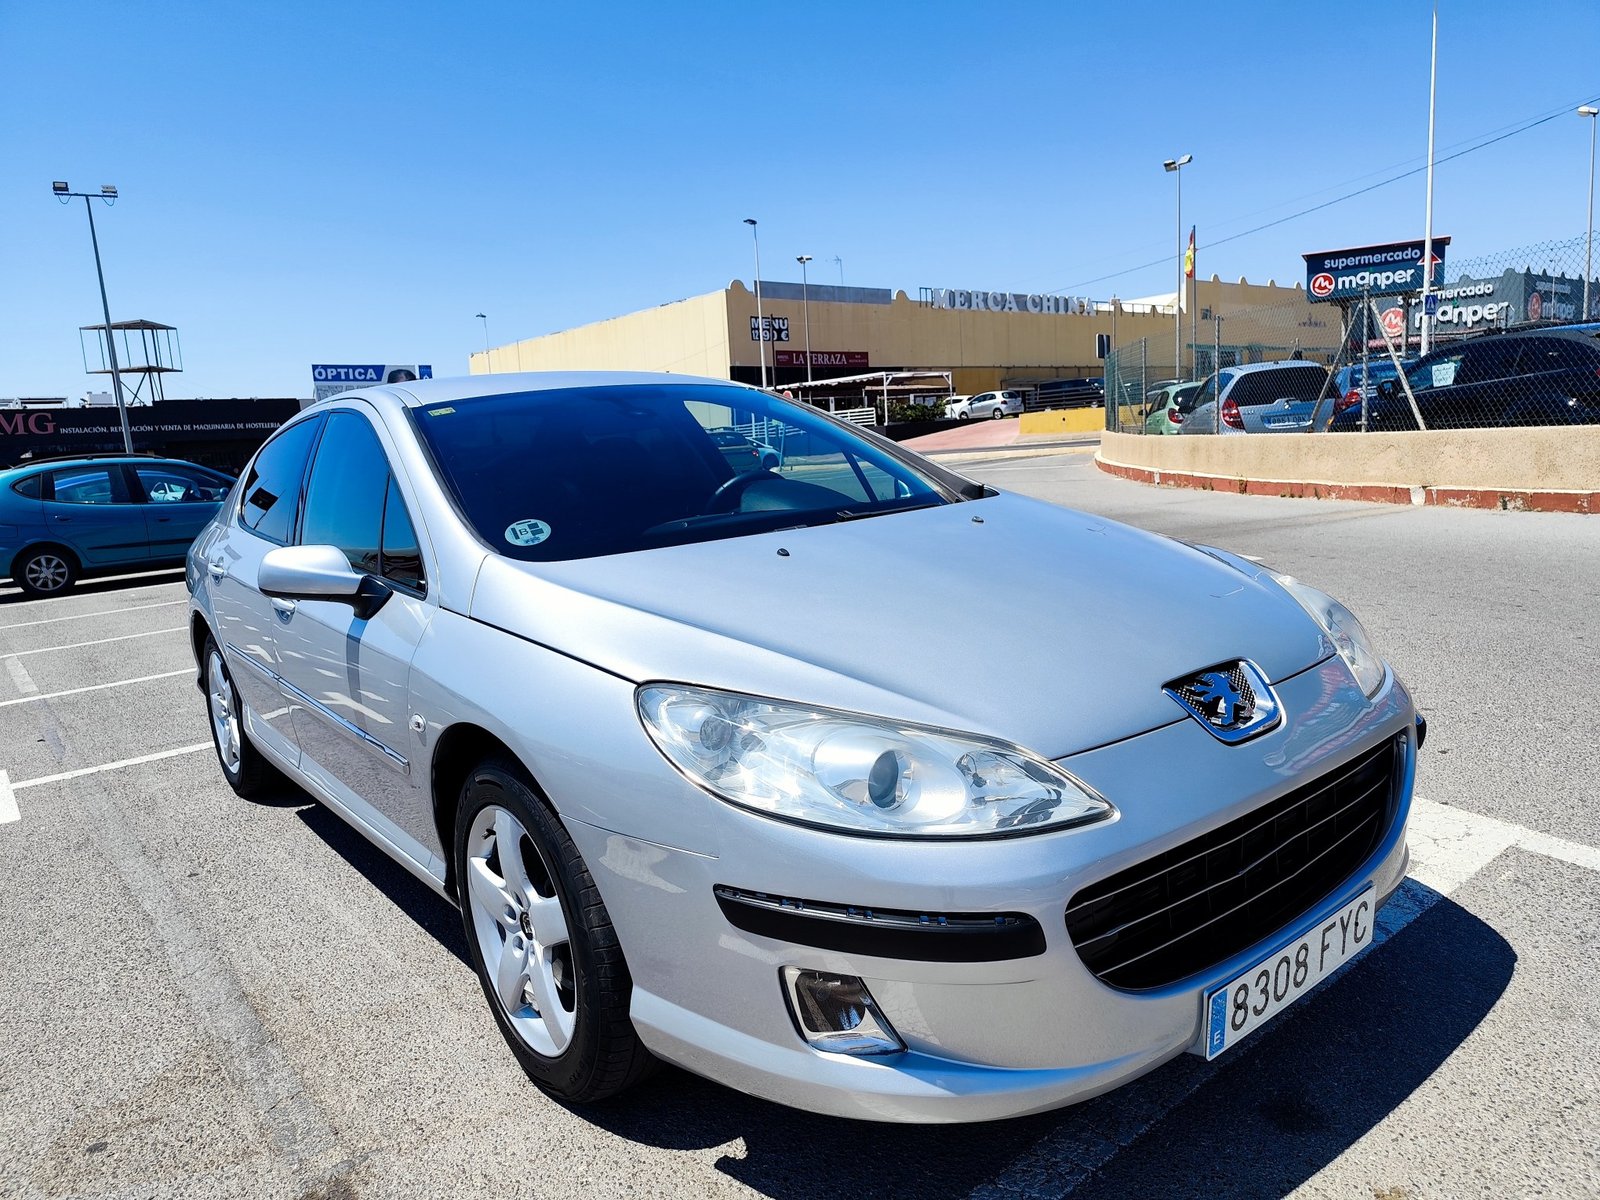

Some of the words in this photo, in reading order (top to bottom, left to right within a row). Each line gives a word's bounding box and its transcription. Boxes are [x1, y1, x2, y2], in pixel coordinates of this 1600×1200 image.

[1324, 248, 1420, 270] supermercado
[1338, 268, 1415, 290] manper
[933, 288, 1020, 313] MERCA
[1026, 293, 1097, 316] CHINA
[751, 317, 788, 329] MENU
[781, 331, 789, 340] €
[793, 353, 804, 364] LA
[314, 366, 377, 380] ÓPTICA
[154, 424, 160, 432] Y
[183, 423, 192, 431] DE
[193, 422, 236, 431] MAQUINARIA
[1231, 942, 1309, 1032] 8308
[1319, 900, 1369, 973] FYC
